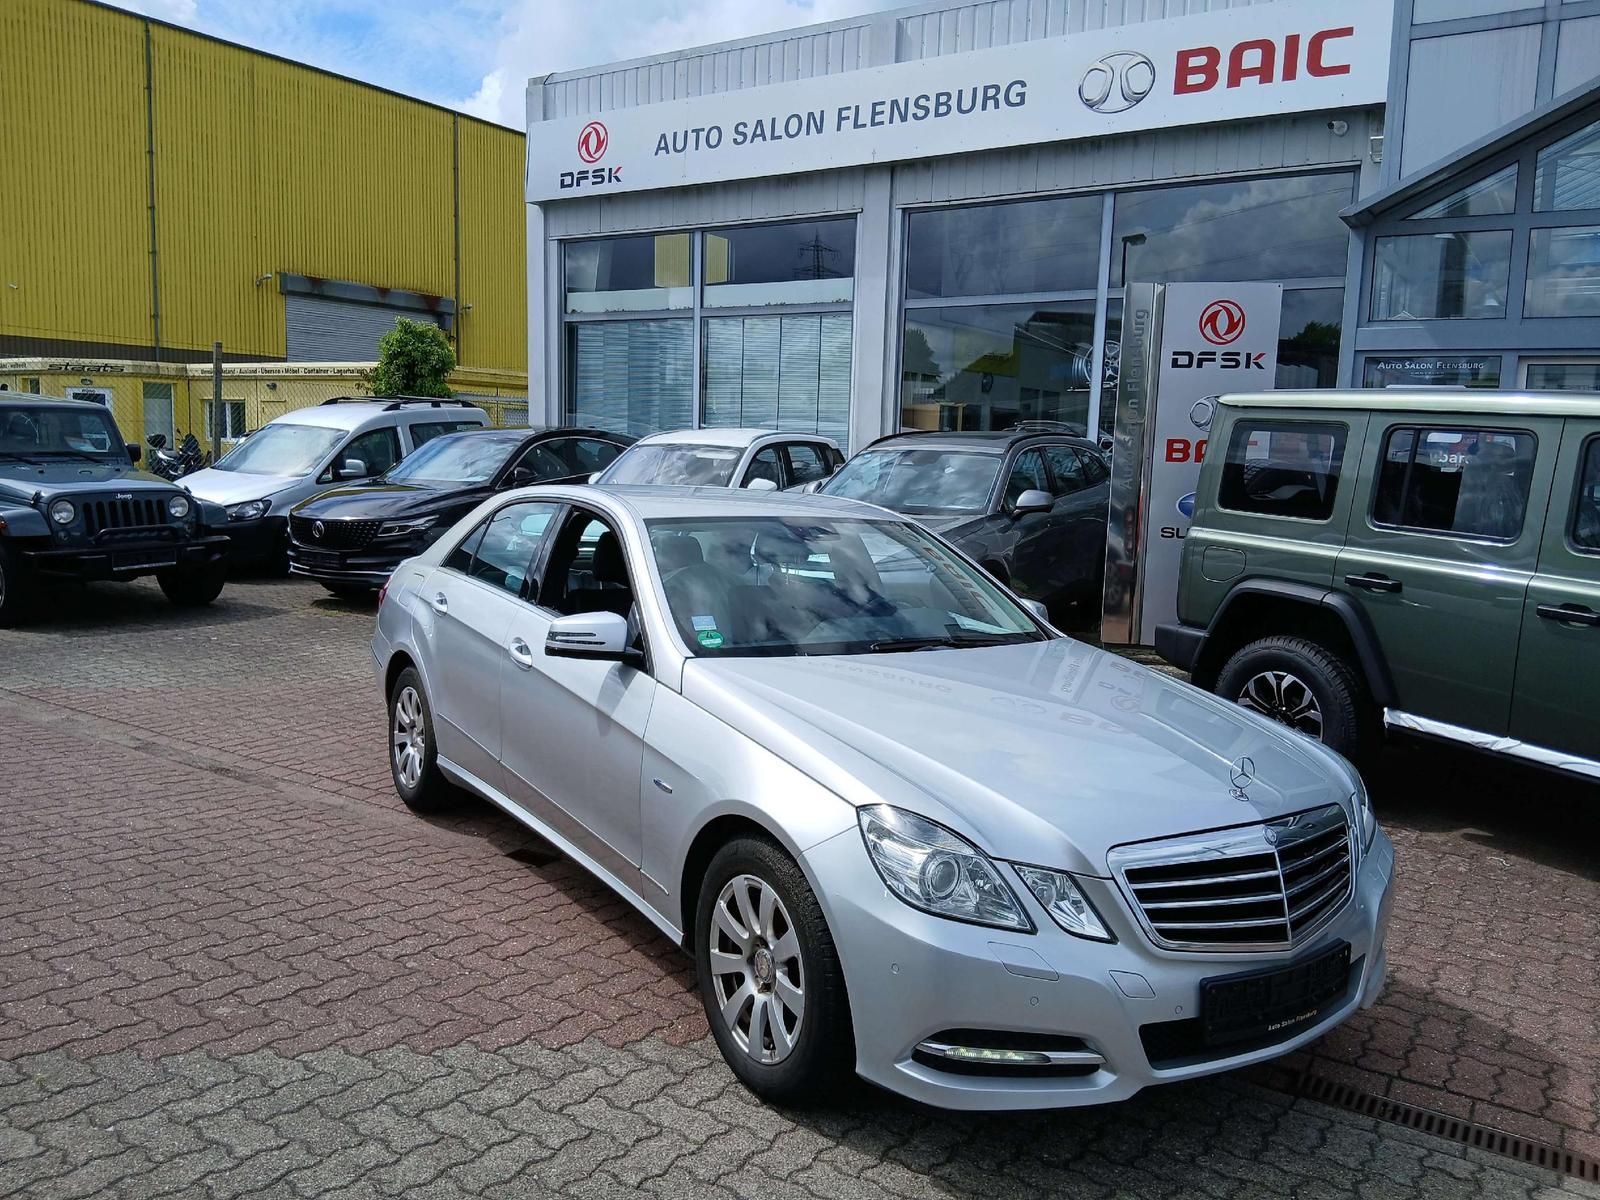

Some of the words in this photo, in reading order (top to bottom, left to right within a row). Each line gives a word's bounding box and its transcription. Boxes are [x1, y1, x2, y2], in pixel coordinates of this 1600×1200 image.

[1174, 26, 1354, 95] BAIC
[654, 125, 724, 156] AUTO
[732, 109, 826, 146] SALON
[836, 79, 1028, 132] FLENSBURG
[559, 165, 623, 189] DFSK
[1127, 308, 1149, 392] Flensburg
[1171, 350, 1266, 370] DFSK
[303, 367, 329, 375] Container
[1165, 439, 1208, 463] BA
